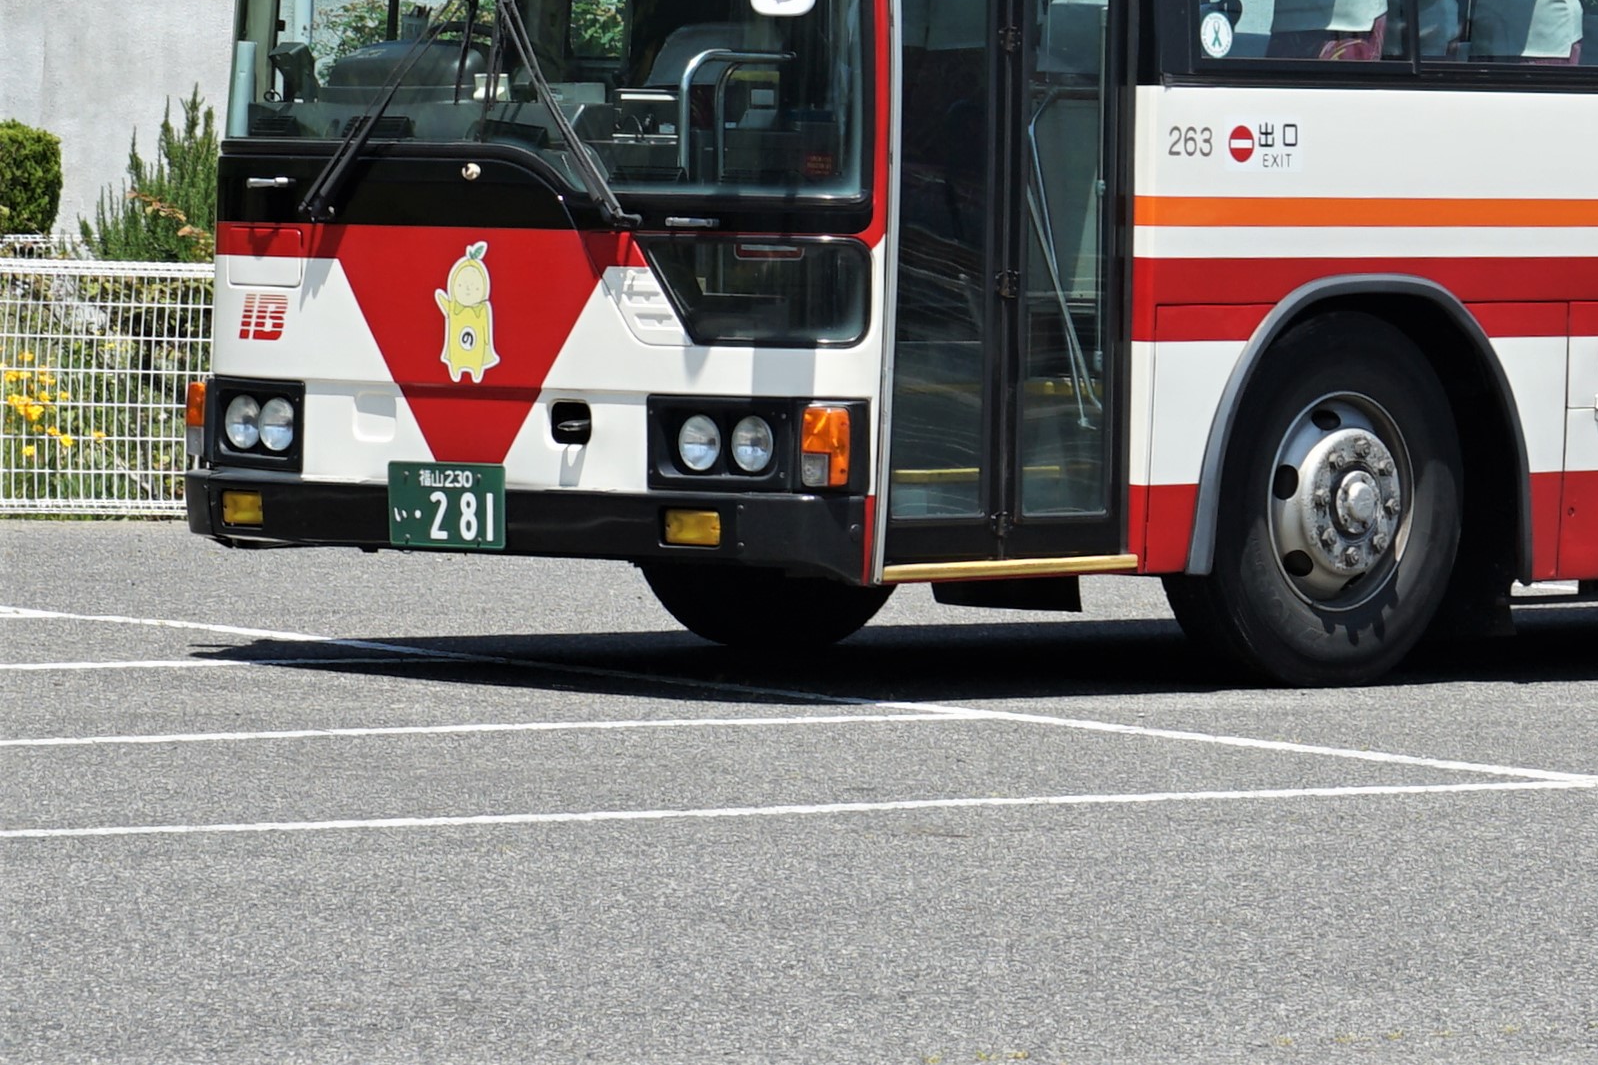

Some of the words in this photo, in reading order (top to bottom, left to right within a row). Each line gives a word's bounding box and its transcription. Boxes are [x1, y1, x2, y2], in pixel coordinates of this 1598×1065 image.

[1168, 125, 1213, 157] 263
[1258, 122, 1298, 147] 出口
[1262, 153, 1293, 168] EXIT
[239, 293, 288, 341] IB
[461, 331, 474, 347] の
